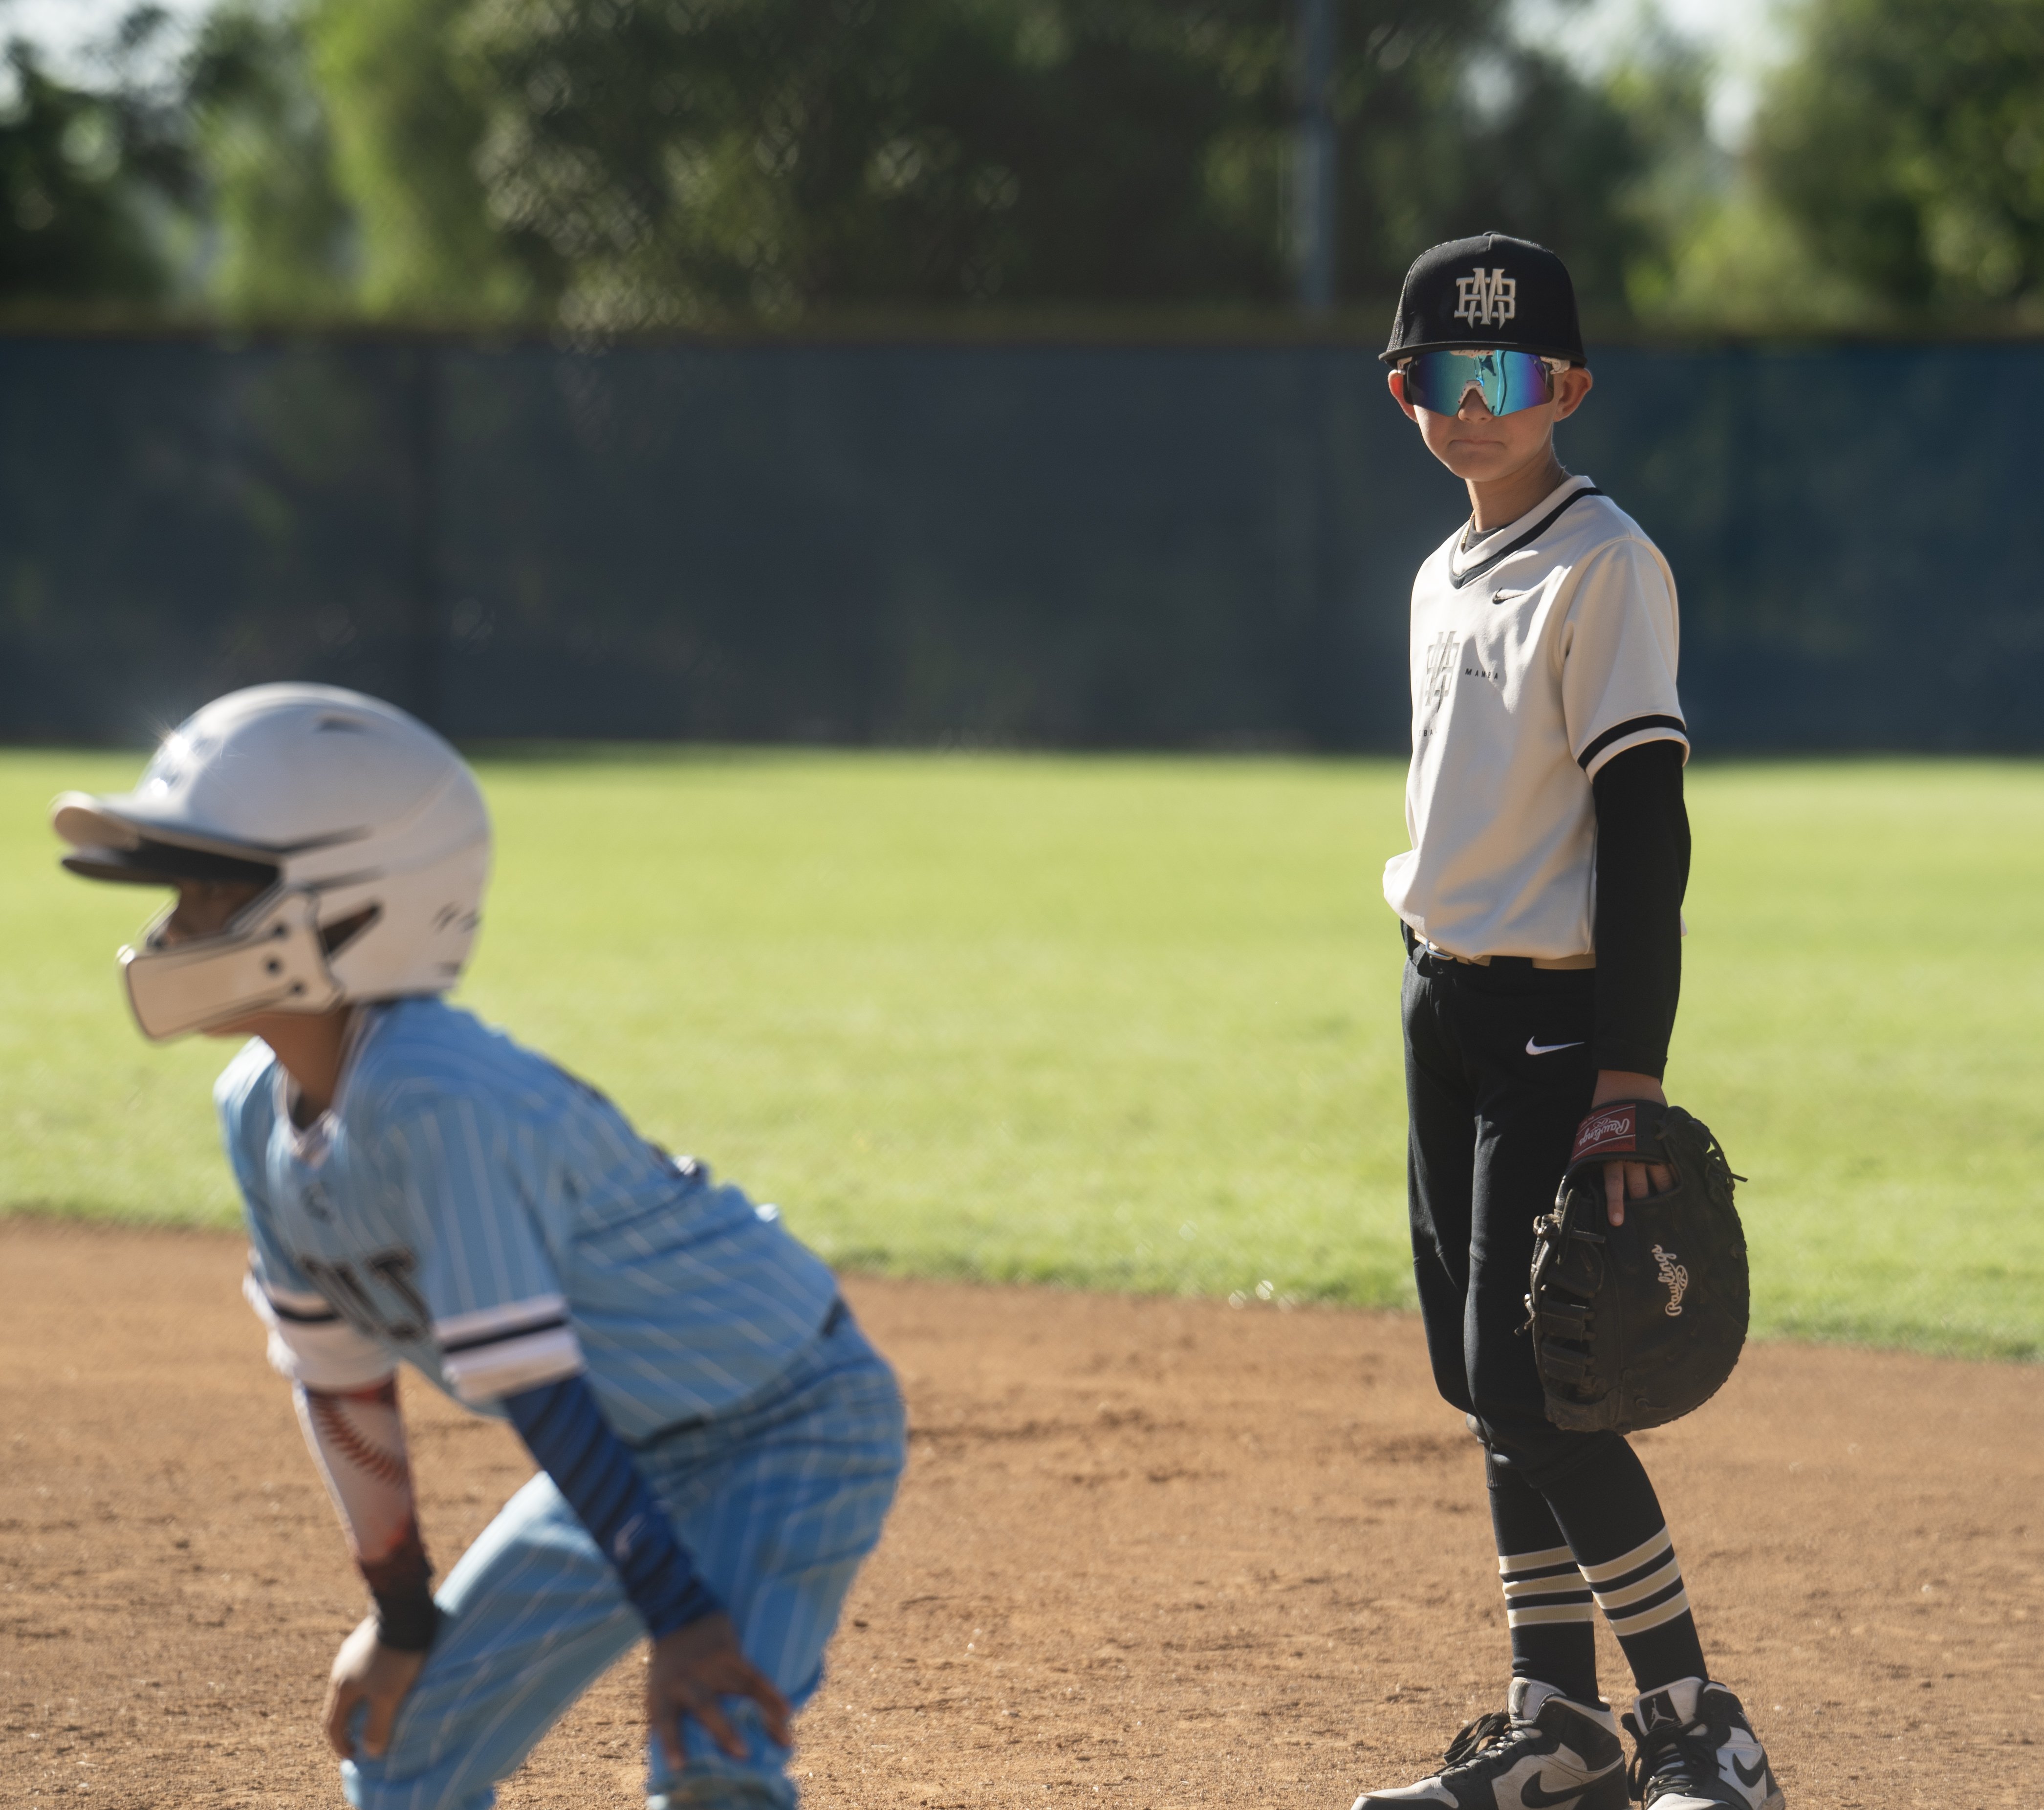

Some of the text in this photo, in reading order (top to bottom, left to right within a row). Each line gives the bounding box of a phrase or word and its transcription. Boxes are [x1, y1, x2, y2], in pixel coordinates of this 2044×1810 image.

[1465, 668, 1499, 680] MAMBA
[1578, 1118, 1630, 1146] Rawlings
[1651, 1244, 1683, 1316] Rawlings
